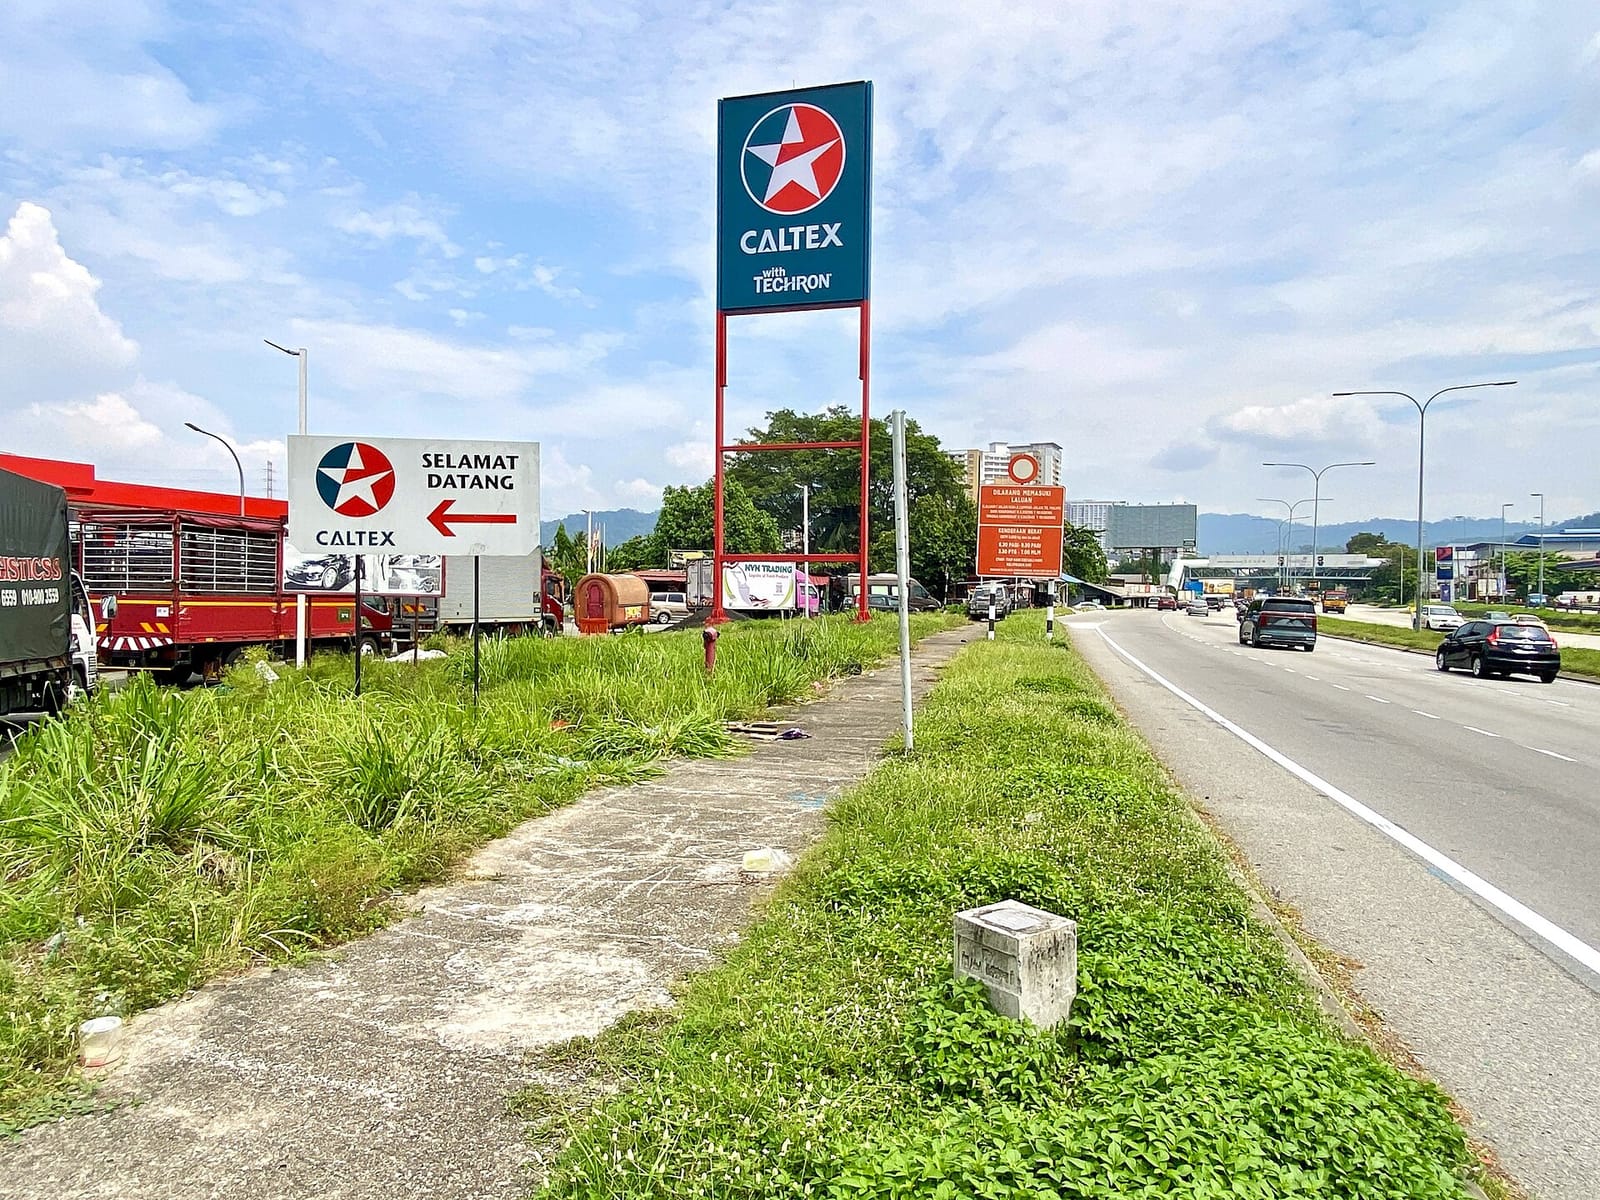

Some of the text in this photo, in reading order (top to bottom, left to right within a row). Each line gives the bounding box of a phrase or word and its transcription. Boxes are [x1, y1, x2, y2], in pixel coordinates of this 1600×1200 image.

[740, 222, 844, 255] CALTEX
[762, 266, 786, 278] with
[753, 274, 831, 294] TECHRON
[422, 453, 519, 470] SELAMAT
[427, 474, 514, 490] DATANG
[316, 530, 396, 546] CALTEX
